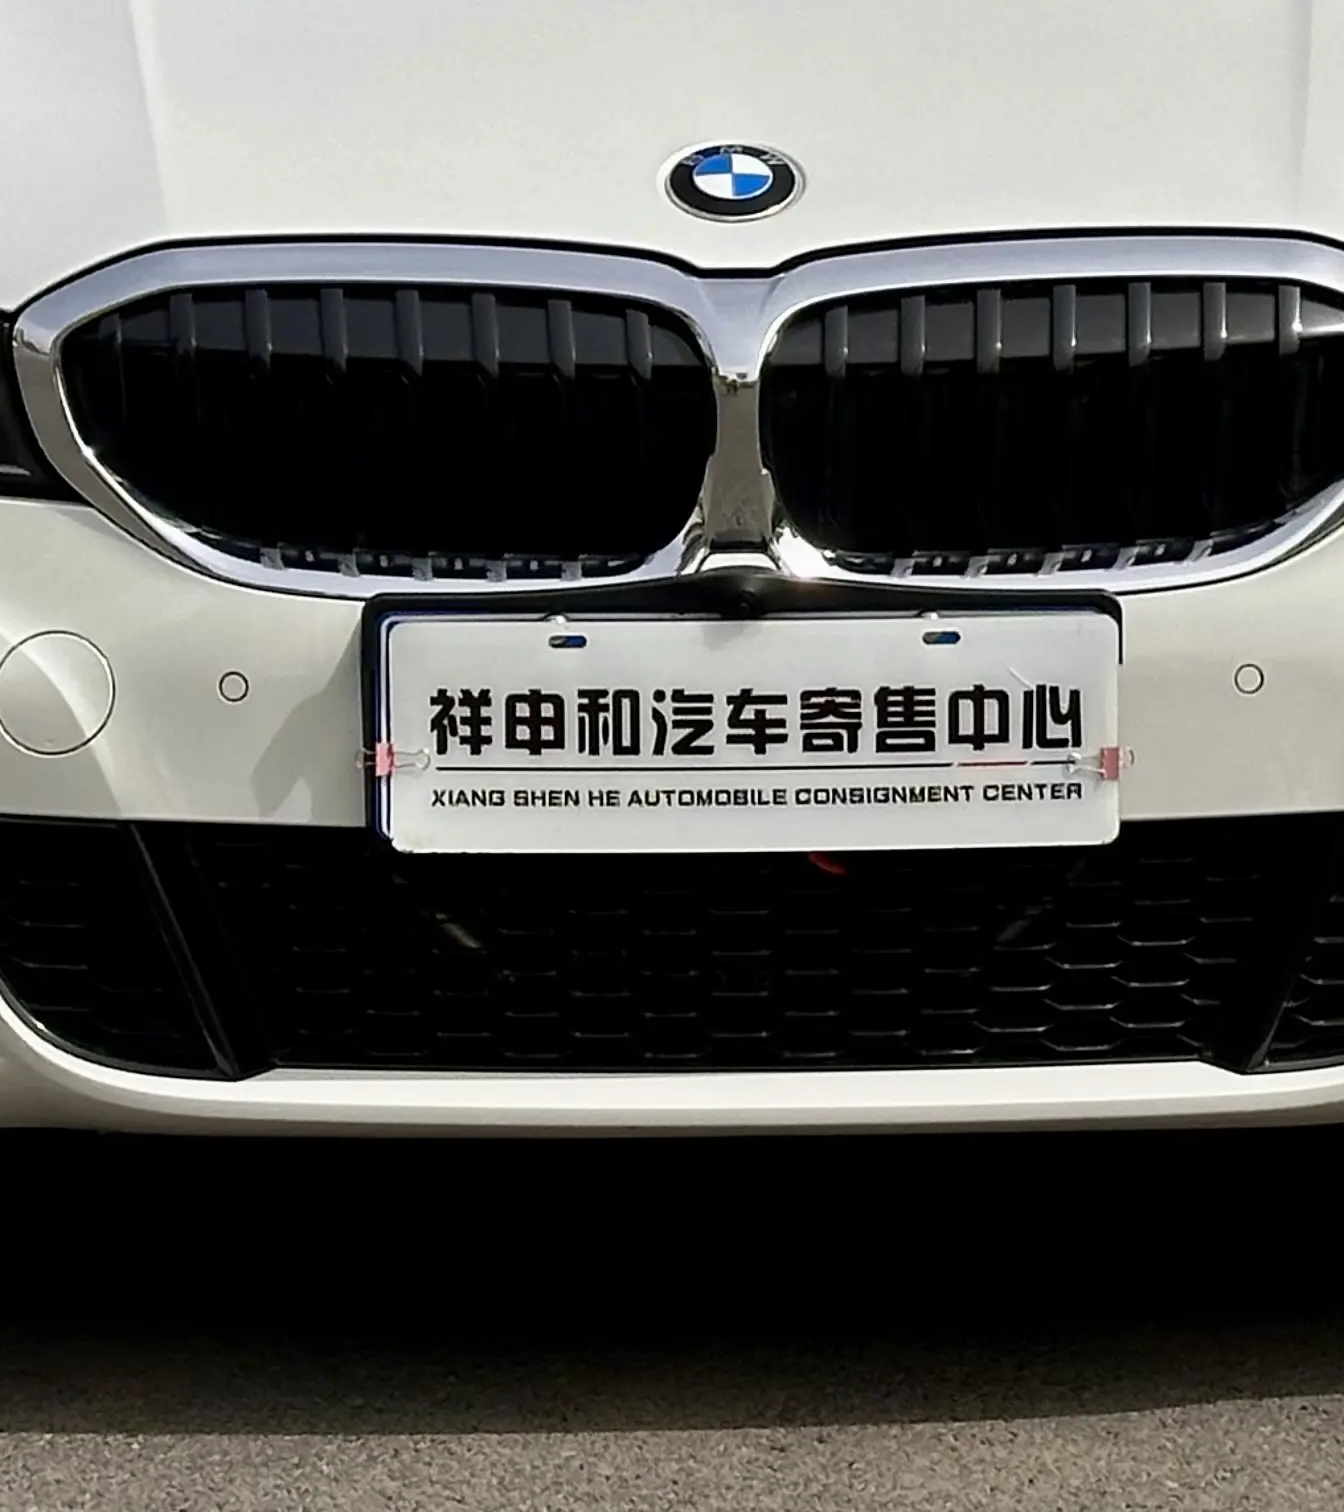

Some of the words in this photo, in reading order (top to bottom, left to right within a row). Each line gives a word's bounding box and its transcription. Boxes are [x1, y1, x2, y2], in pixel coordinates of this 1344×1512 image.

[680, 144, 786, 165] BMW
[430, 684, 1082, 756] 祥申和汽车寄售中心
[431, 789, 505, 807] XIANG
[513, 789, 580, 807] SHEN
[588, 789, 620, 807] HE
[627, 788, 787, 807] AUTOMOBILE
[794, 785, 975, 805] CONSIGNMENT
[982, 782, 1083, 802] CENTER
